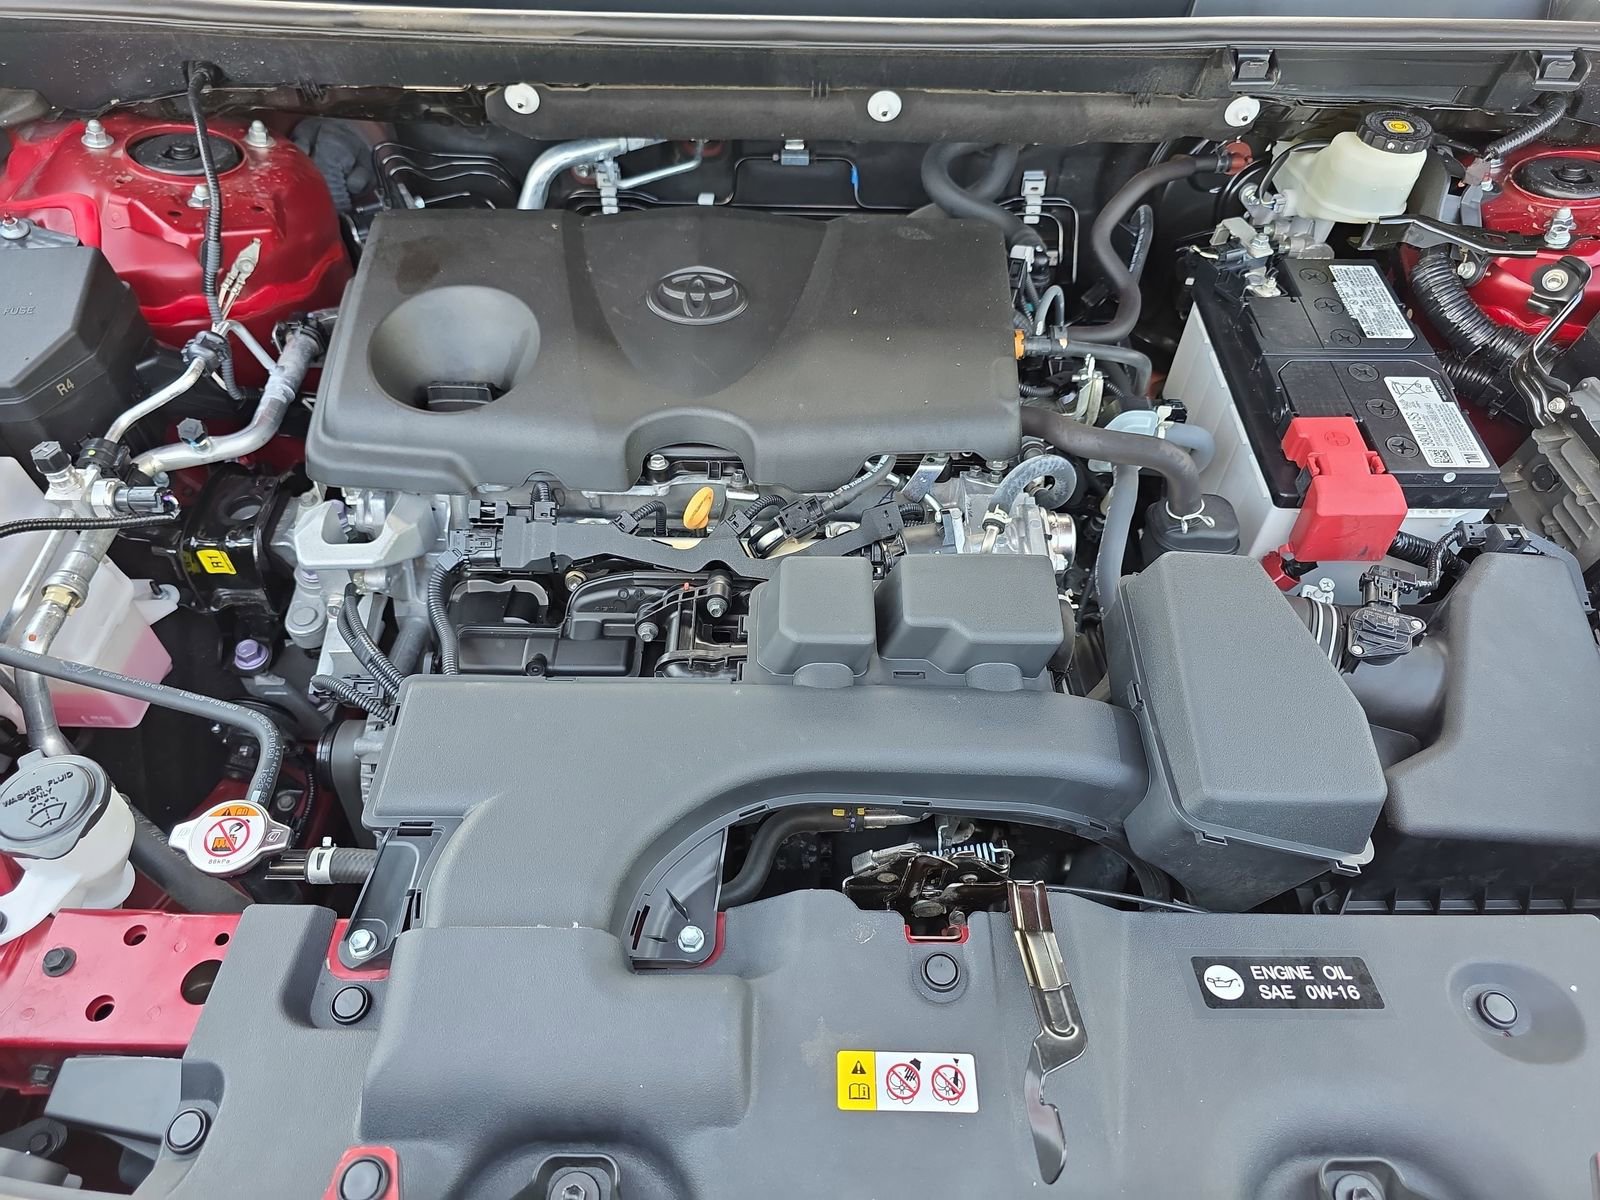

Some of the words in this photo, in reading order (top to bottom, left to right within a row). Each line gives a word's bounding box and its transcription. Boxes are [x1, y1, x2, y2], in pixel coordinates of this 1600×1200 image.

[4, 305, 36, 316] FUSE
[55, 378, 75, 396] R4
[207, 555, 224, 568] R1
[2, 785, 43, 808] WASHER
[48, 771, 74, 787] FLUID
[28, 787, 52, 803] ONLY
[1249, 965, 1314, 980] ENGINE
[1322, 965, 1353, 980] OIL
[1259, 985, 1296, 1000] SAE
[1305, 985, 1361, 1000] 0W-16
